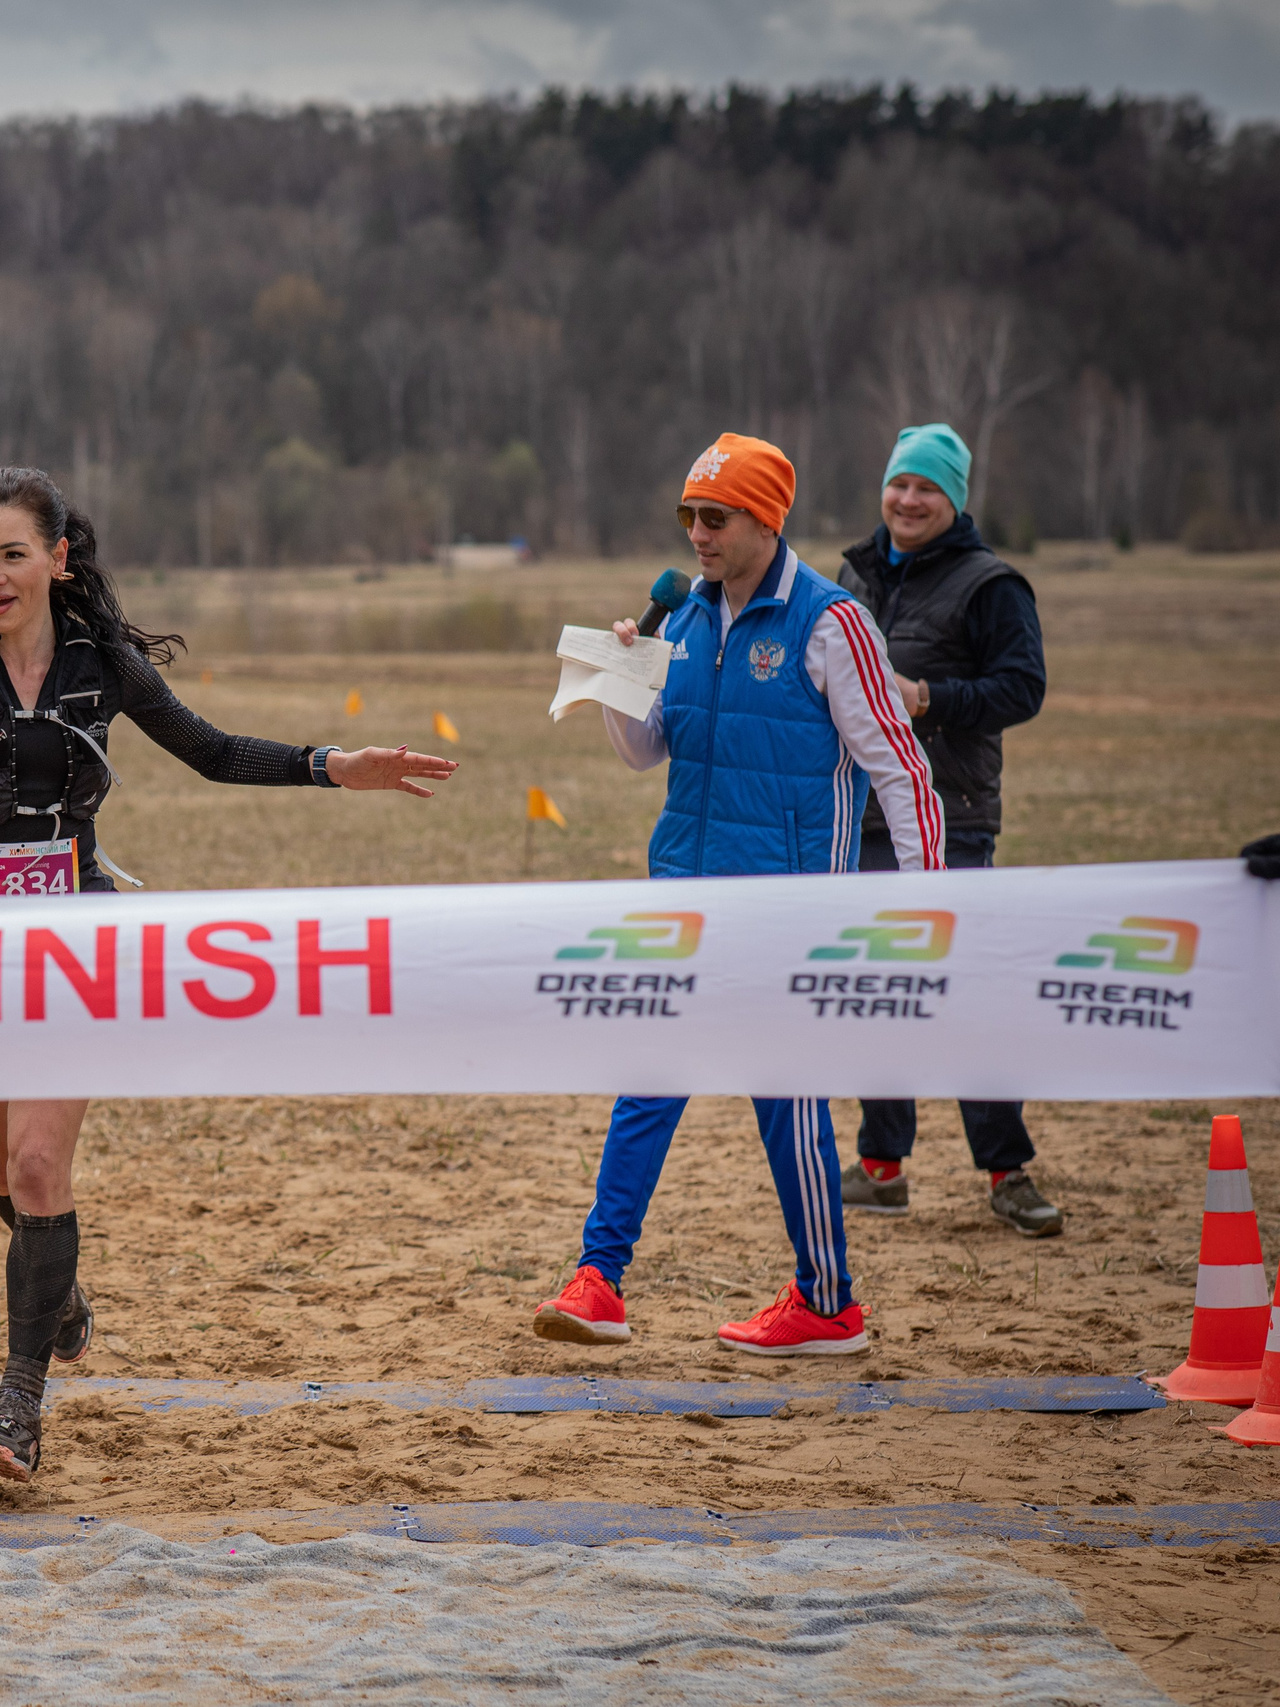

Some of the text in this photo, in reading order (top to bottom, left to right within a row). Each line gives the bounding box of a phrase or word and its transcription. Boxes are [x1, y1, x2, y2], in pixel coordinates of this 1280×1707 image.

[59, 843, 70, 853] ЛЕС
[5, 868, 68, 897] 834
[537, 974, 695, 993] DREAM
[789, 974, 948, 995] DREAM
[1039, 980, 1193, 1009] DREAM
[557, 997, 680, 1018] TRAIL
[810, 998, 933, 1019] TRAIL
[1059, 1005, 1180, 1030] TRAIL
